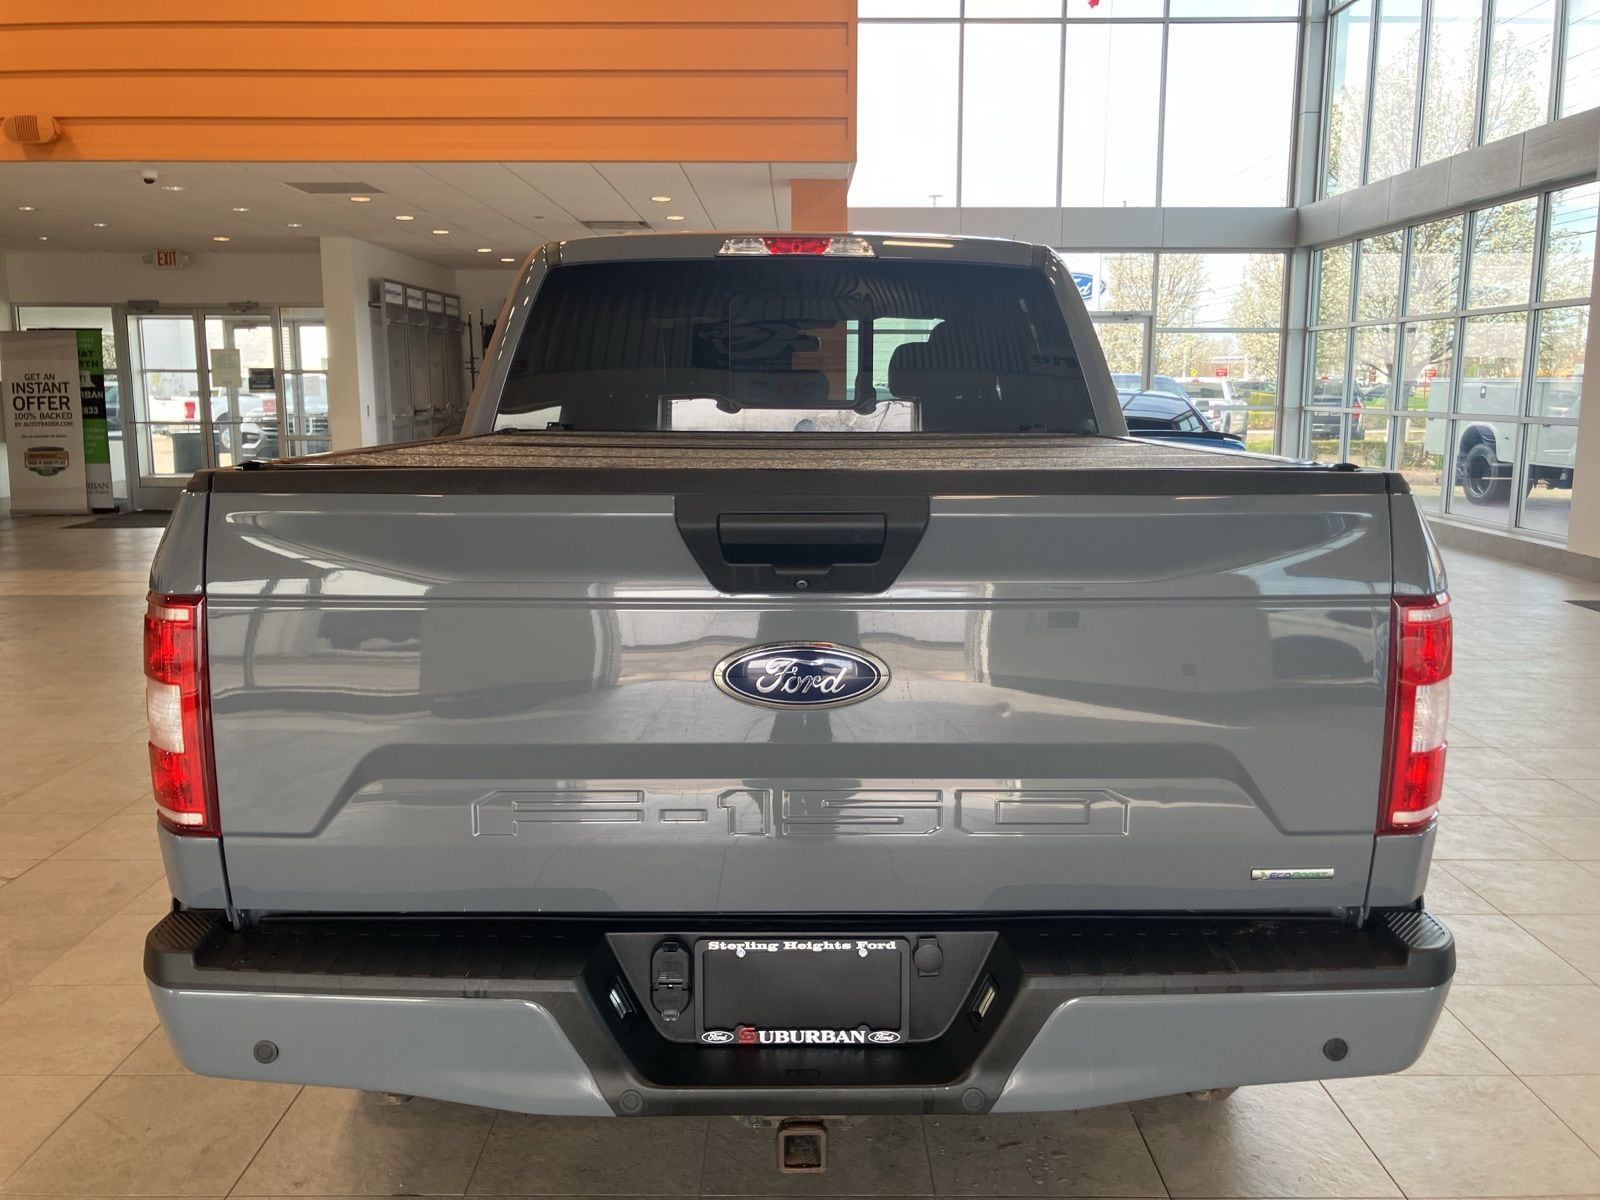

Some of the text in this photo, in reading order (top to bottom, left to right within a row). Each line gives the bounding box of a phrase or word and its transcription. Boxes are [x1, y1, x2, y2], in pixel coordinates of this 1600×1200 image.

[157, 250, 177, 267] EXIT
[24, 373, 55, 381] GET AN
[11, 381, 70, 394] INSTANT
[12, 395, 71, 411] OFFER
[14, 412, 73, 420] 100% BACKED
[756, 657, 848, 694] Ford
[471, 788, 1131, 837] F-150
[708, 941, 897, 952] Sterling Heights Ford
[737, 1027, 866, 1044] SUBURBAN
